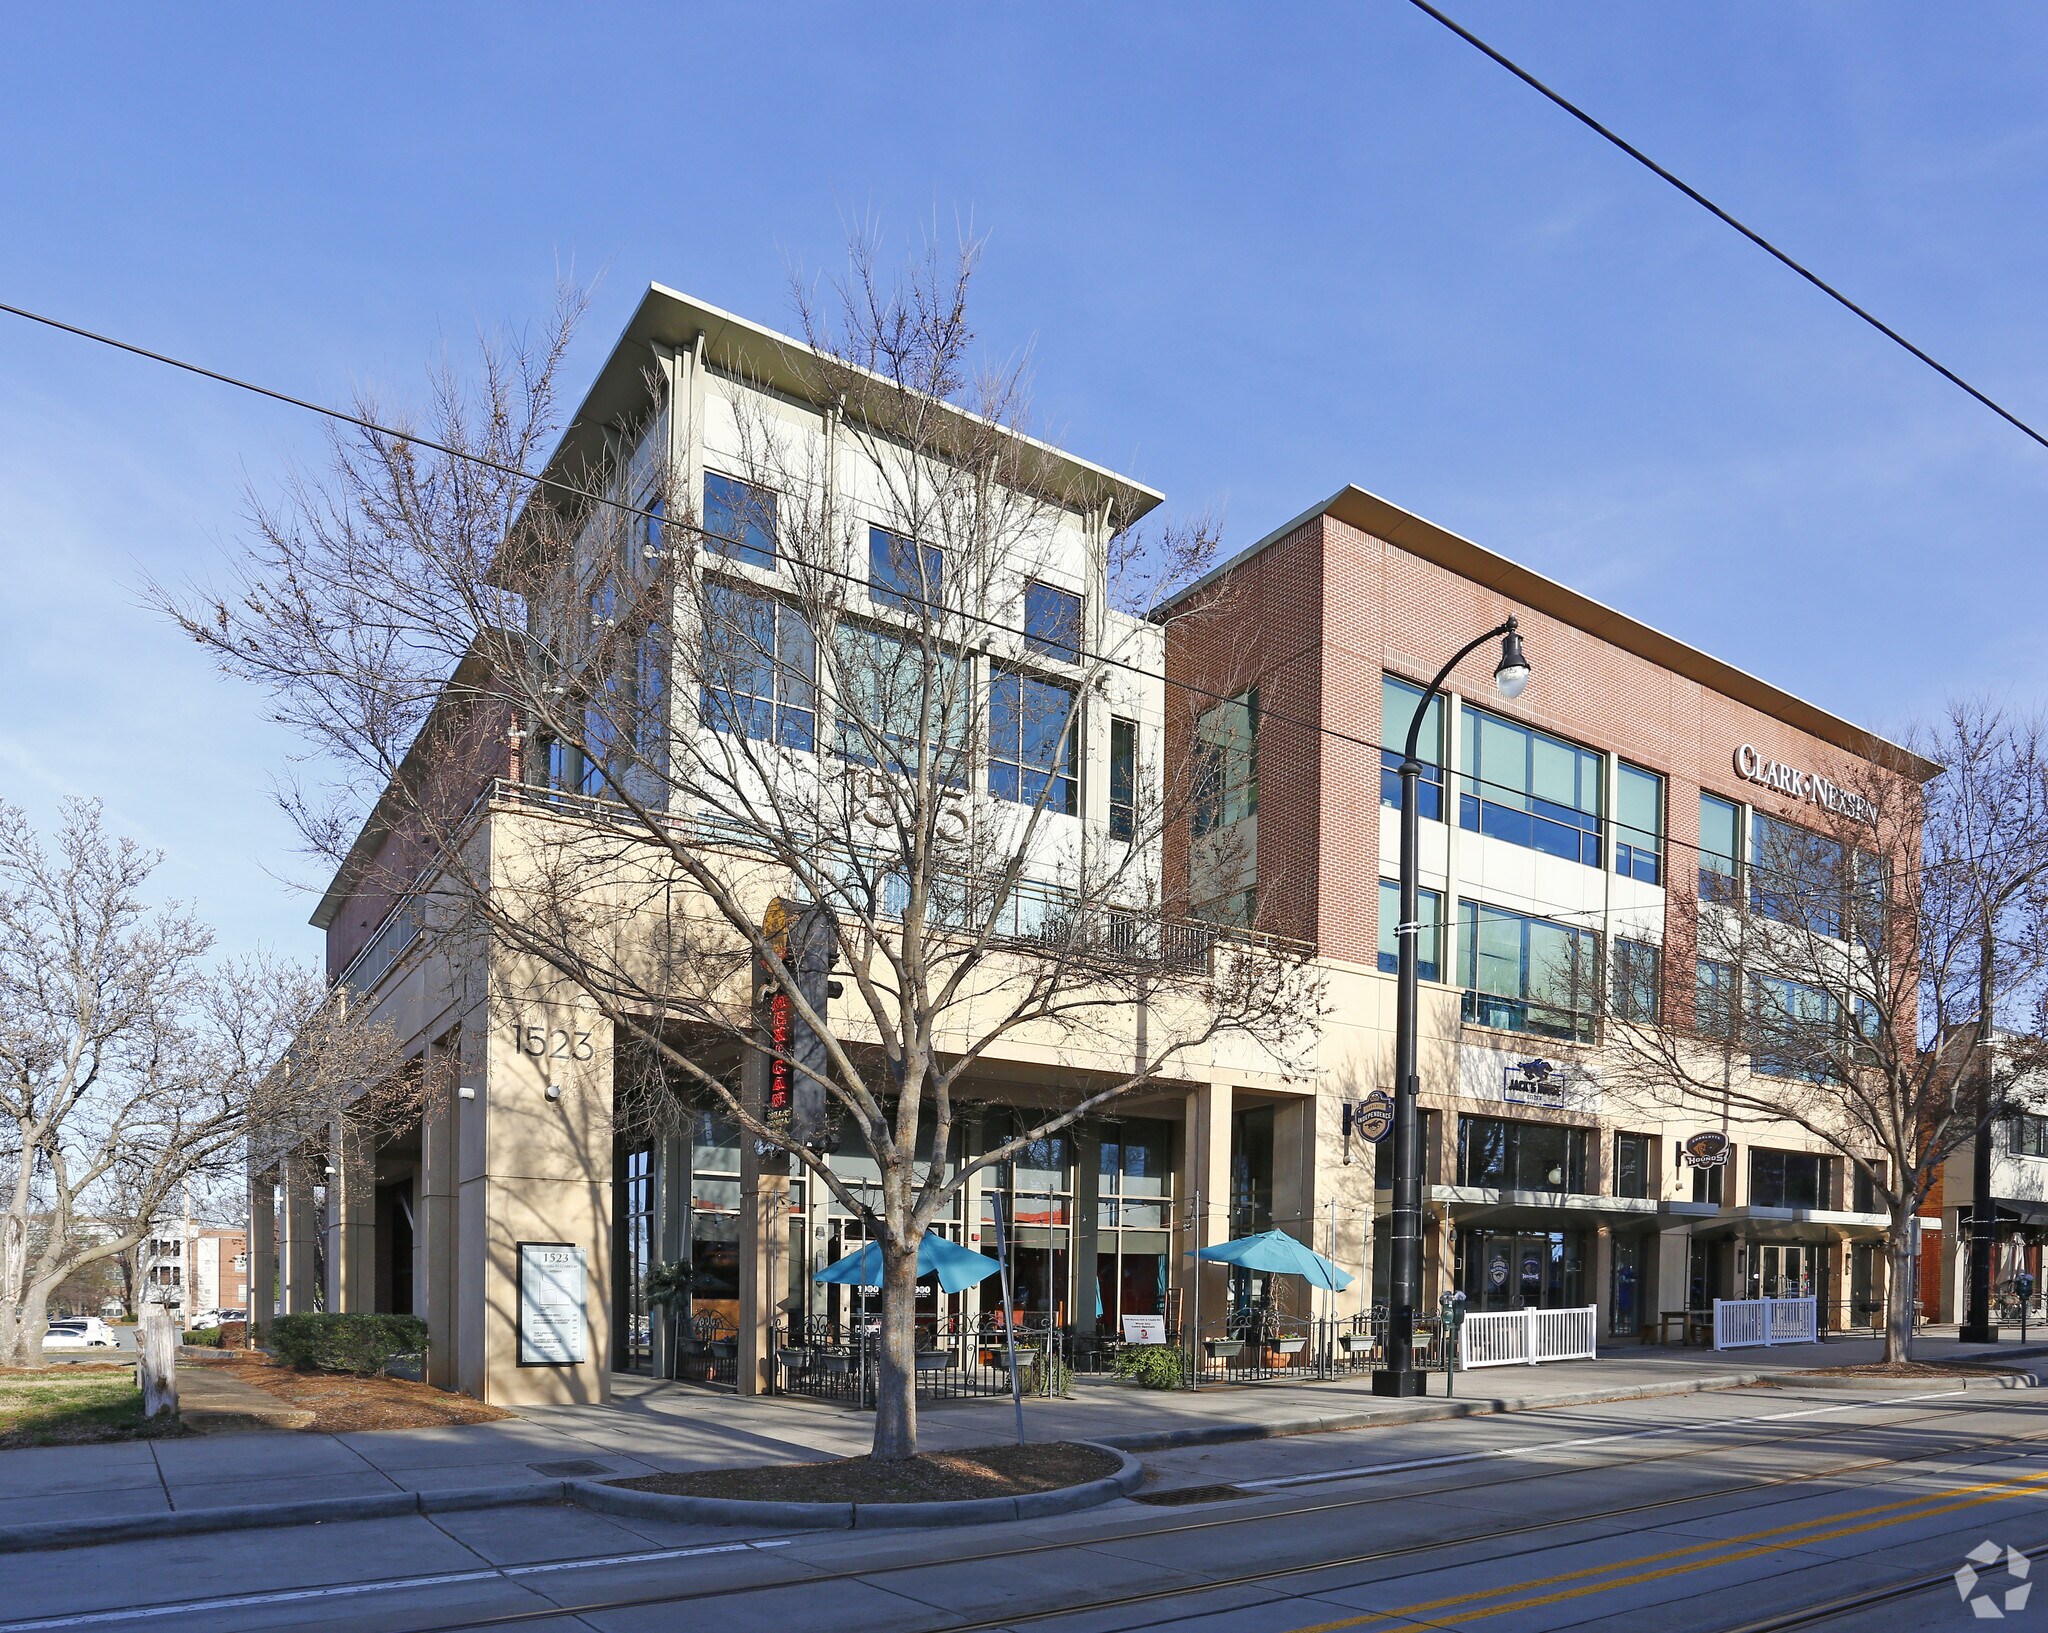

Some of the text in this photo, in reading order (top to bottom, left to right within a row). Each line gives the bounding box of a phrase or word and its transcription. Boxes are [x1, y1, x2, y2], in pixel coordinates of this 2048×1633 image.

[1734, 743, 1804, 797] CLARK
[512, 1024, 594, 1061] 1523
[1357, 1111, 1392, 1124] INDEPENDENCE
[1692, 1135, 1721, 1143] CHARLOTTE
[1688, 1153, 1724, 1164] HOUNDS
[544, 1253, 569, 1263] 1523
